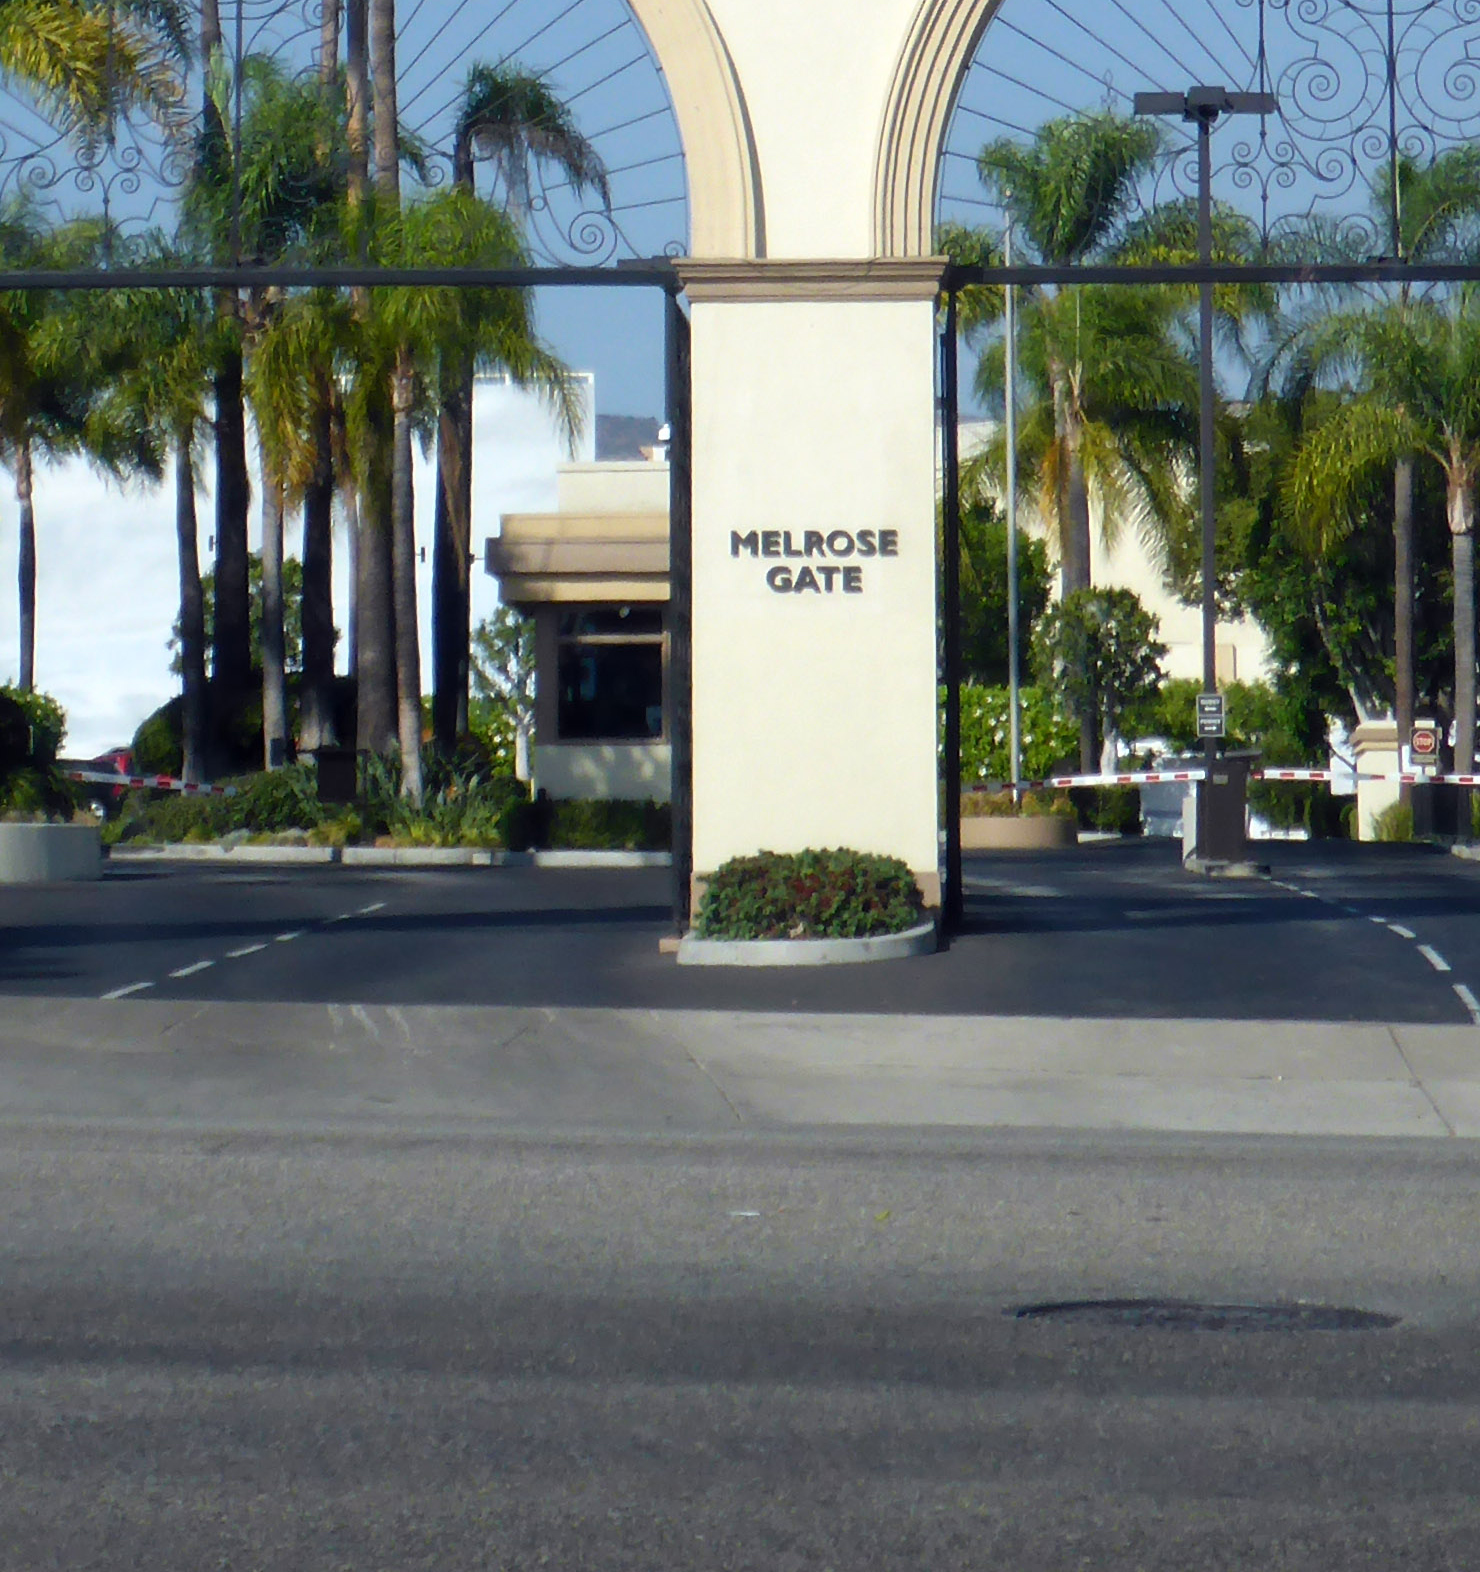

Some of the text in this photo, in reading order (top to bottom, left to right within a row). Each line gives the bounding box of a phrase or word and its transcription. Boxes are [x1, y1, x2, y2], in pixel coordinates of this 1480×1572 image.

[729, 529, 899, 559] MELROSE
[765, 565, 864, 595] GATE
[1414, 737, 1433, 747] STOP
